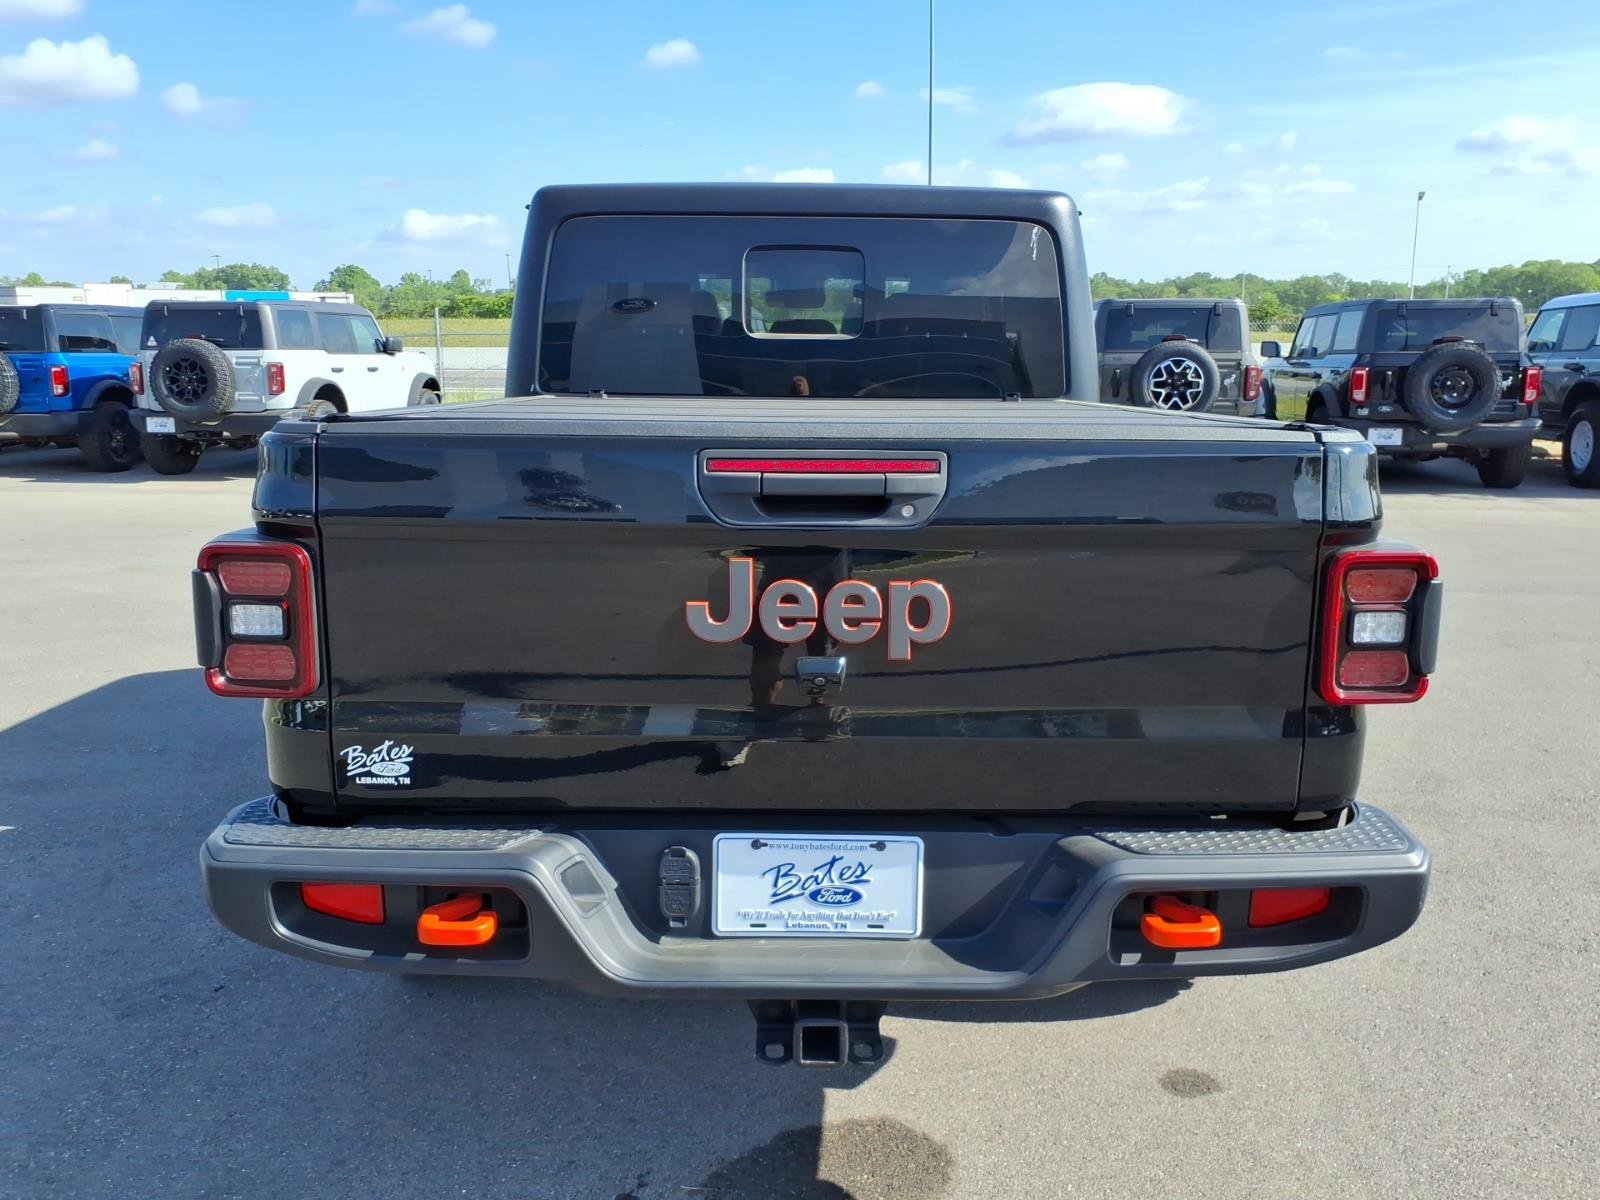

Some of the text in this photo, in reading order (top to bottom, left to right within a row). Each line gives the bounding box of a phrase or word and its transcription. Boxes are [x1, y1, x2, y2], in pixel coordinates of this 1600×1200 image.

[686, 557, 951, 660] Jeep
[340, 740, 414, 772] Bates
[356, 777, 397, 786] LEBANON,
[769, 842, 868, 852] www.tonybatesford.com
[762, 855, 873, 900] Bates
[816, 887, 852, 904] Ford
[800, 911, 835, 922] Anything
[785, 922, 848, 930] Lebanon, TN
